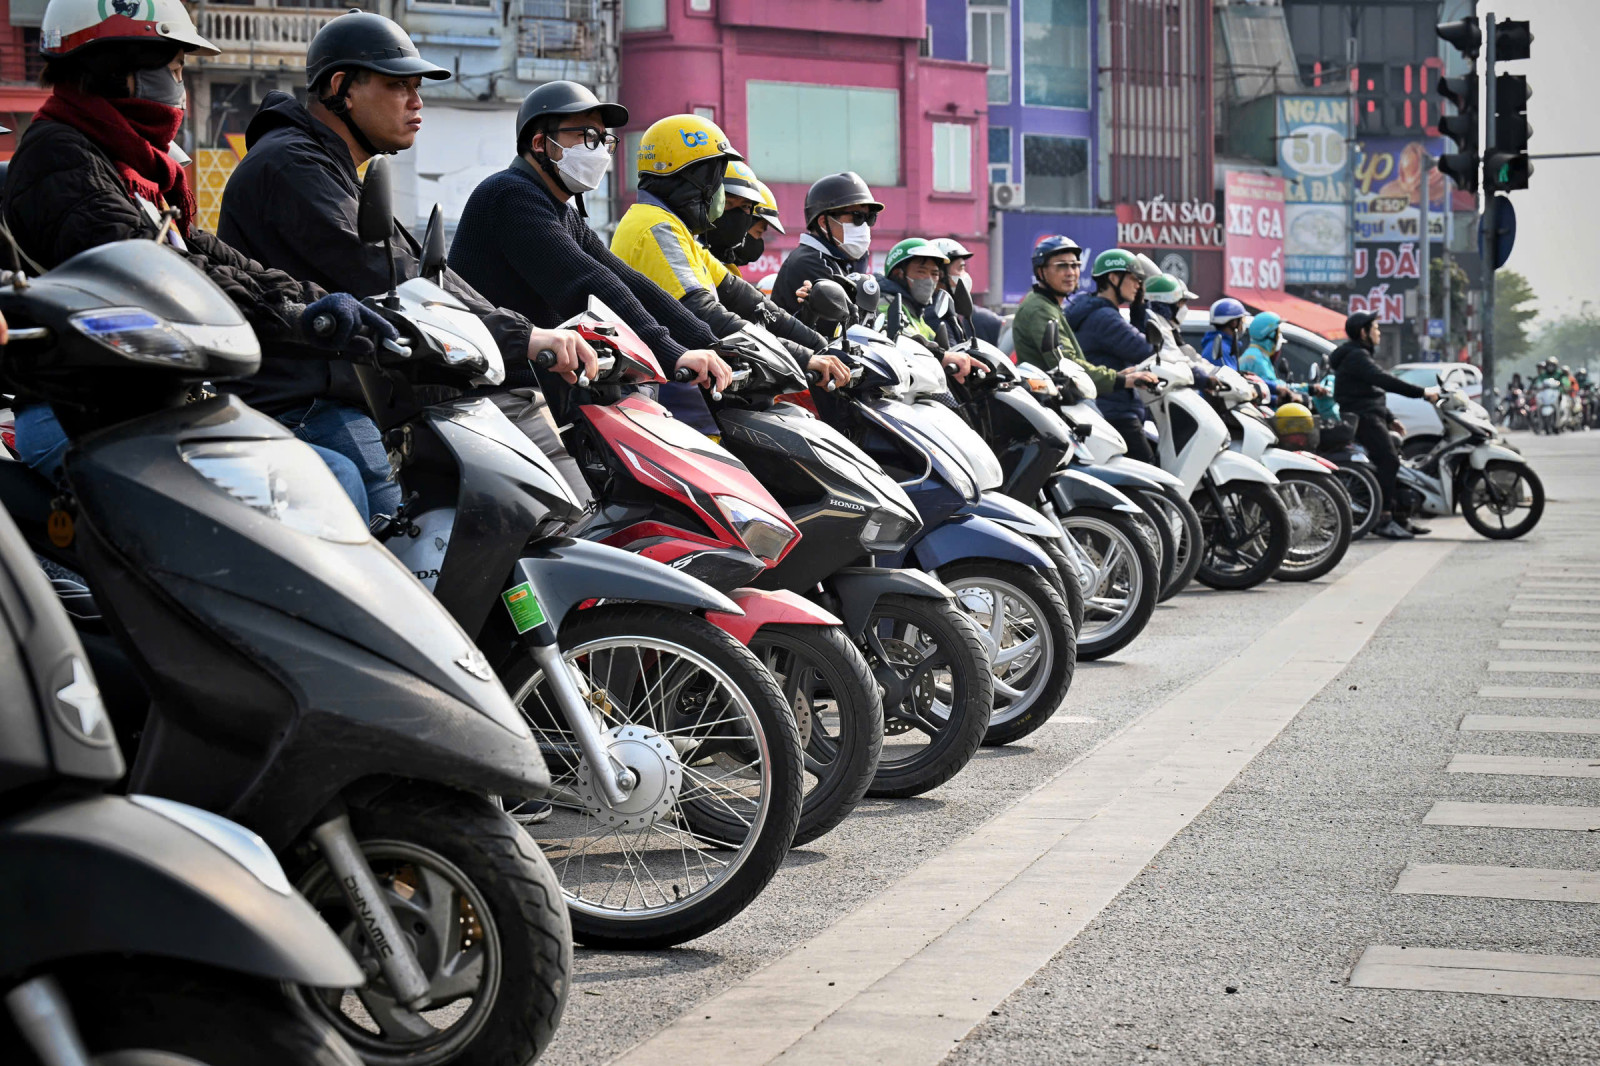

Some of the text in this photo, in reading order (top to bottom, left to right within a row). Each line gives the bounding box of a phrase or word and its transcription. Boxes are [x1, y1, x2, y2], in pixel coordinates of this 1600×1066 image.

[1283, 99, 1348, 124] NGAN
[679, 128, 709, 148] be
[1137, 194, 1216, 224] YẾN SÀO
[1228, 203, 1283, 239] XE GA
[1117, 222, 1156, 244] HOA
[1157, 225, 1196, 245] ANH
[1104, 257, 1126, 267] Grab
[1229, 255, 1255, 287] XE
[1258, 246, 1282, 289] SỐ
[829, 499, 866, 512] HONDA
[343, 875, 394, 959] DYNAMIC
